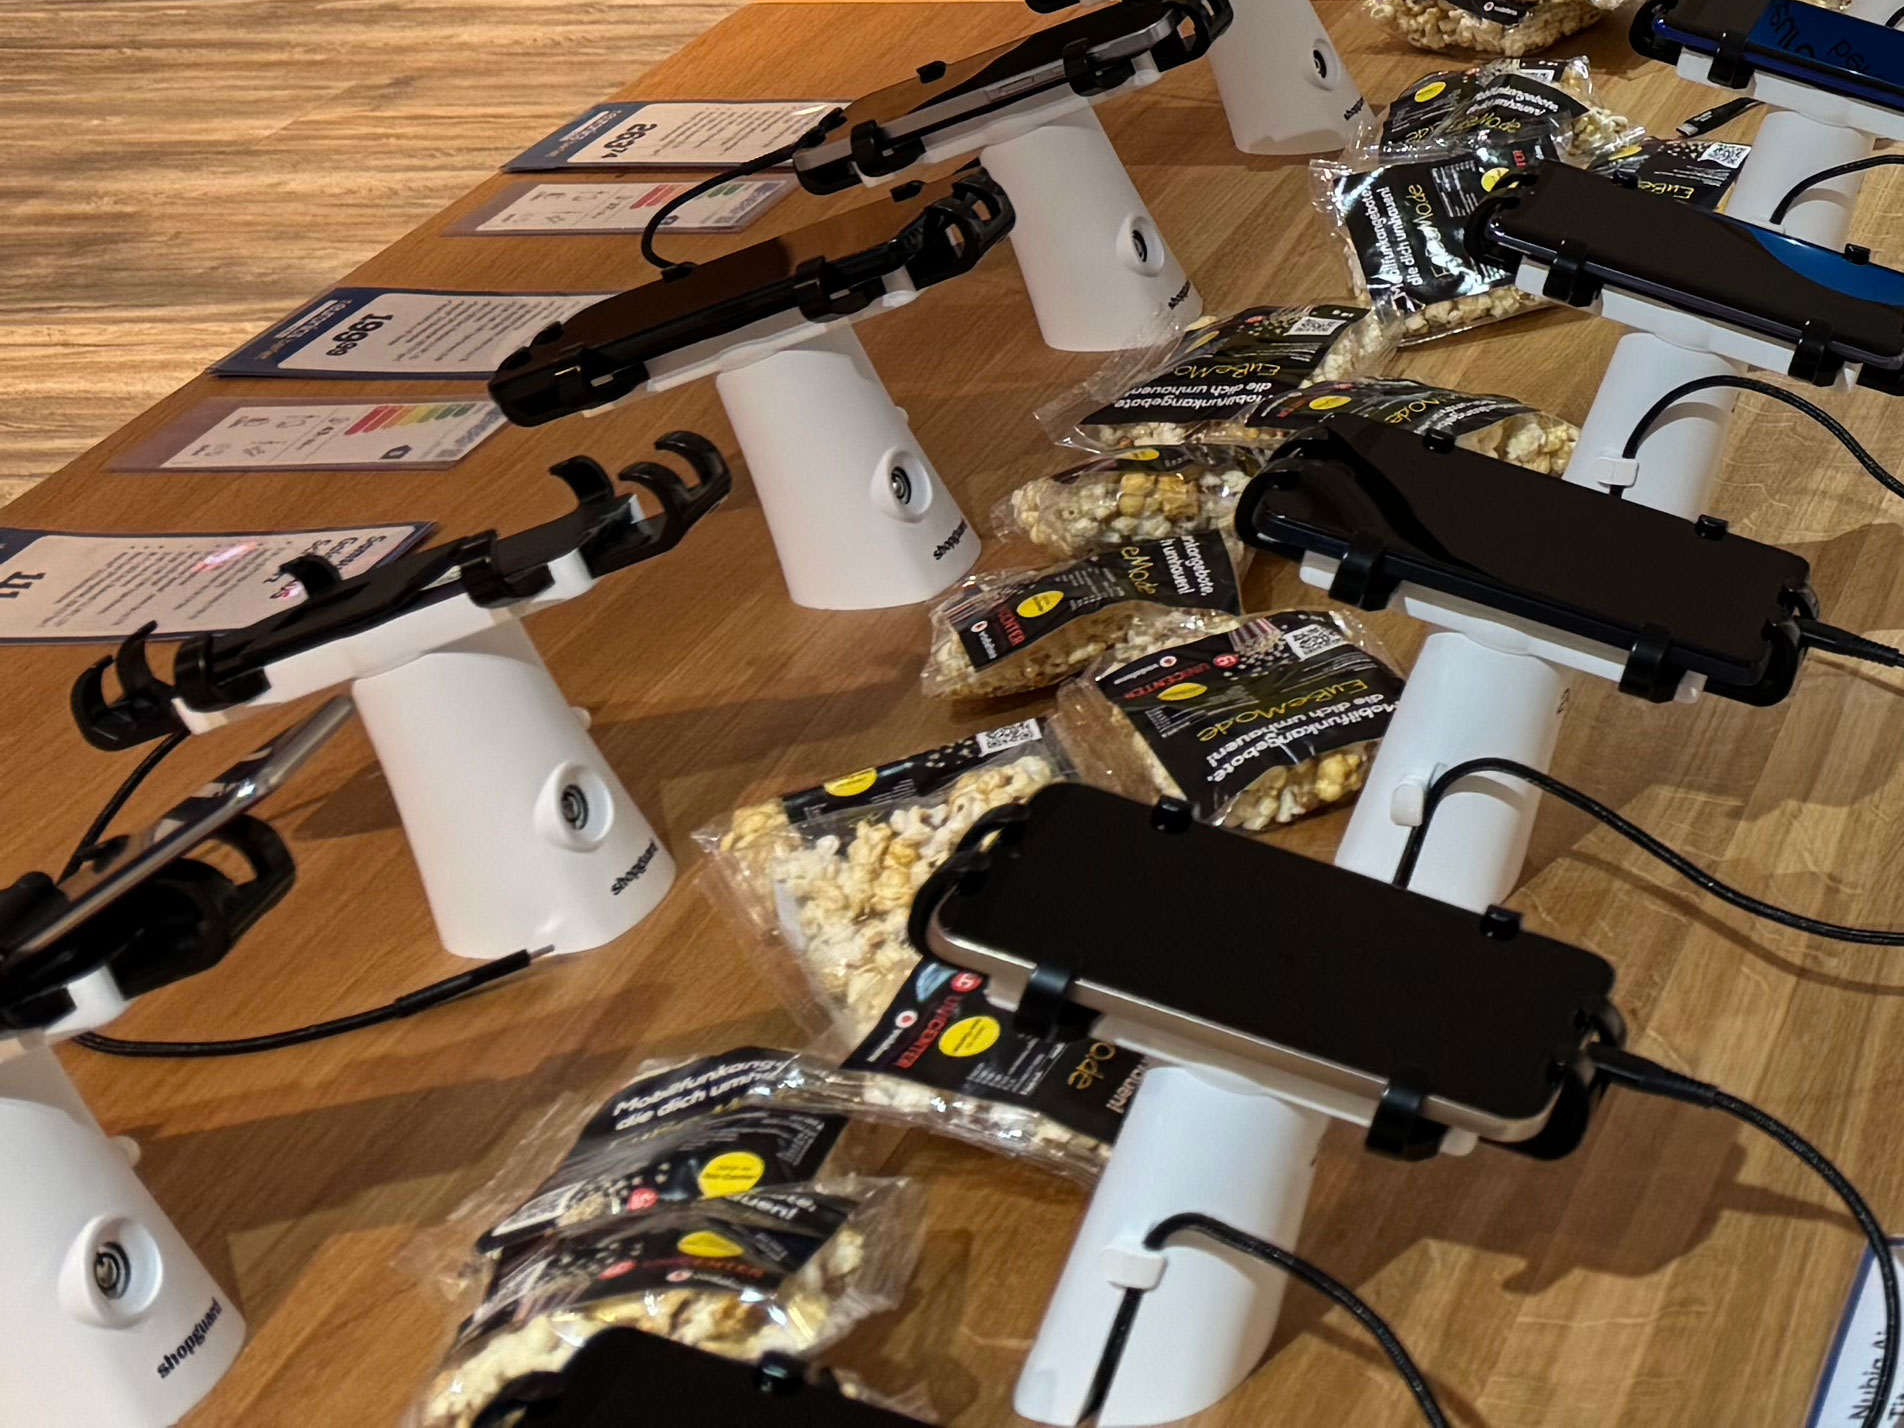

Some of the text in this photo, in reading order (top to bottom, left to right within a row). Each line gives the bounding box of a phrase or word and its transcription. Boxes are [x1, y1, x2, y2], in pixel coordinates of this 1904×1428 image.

[1308, 699, 1349, 720] dich
[1206, 713, 1307, 768] umhauen!
[612, 1058, 783, 1117] Mobilfunkang
[615, 1089, 706, 1131] die dich
[155, 1298, 225, 1381] shopguard
